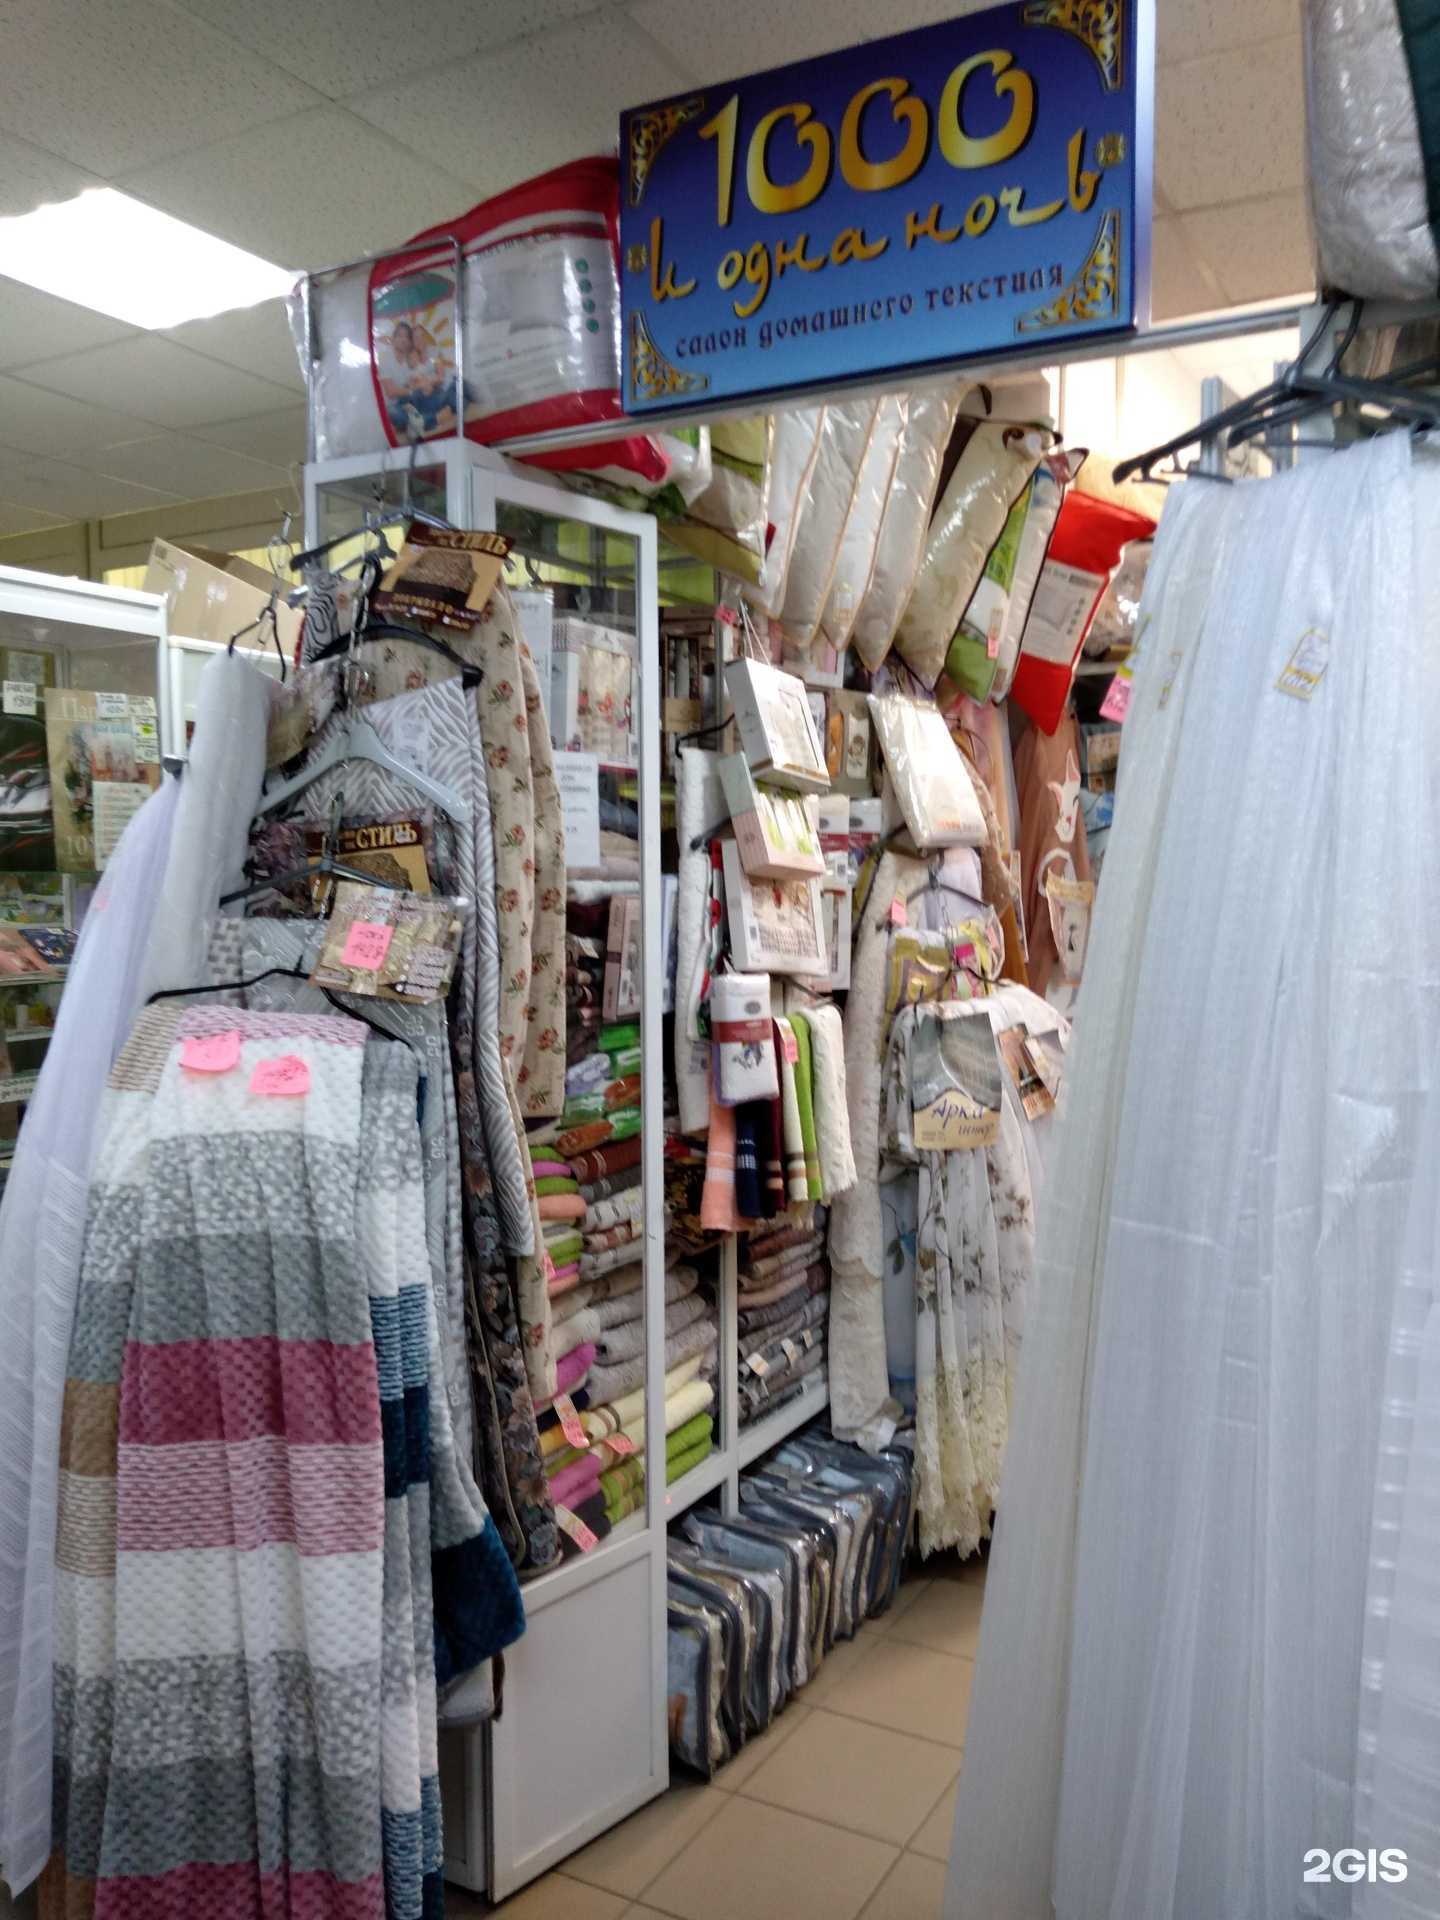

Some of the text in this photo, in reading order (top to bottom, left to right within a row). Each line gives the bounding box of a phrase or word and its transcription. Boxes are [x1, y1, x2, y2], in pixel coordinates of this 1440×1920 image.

[700, 49, 1034, 227] 1000
[717, 227, 889, 318] одна
[906, 128, 1100, 249] ночь
[675, 264, 1064, 359] салон домашнего текстиля
